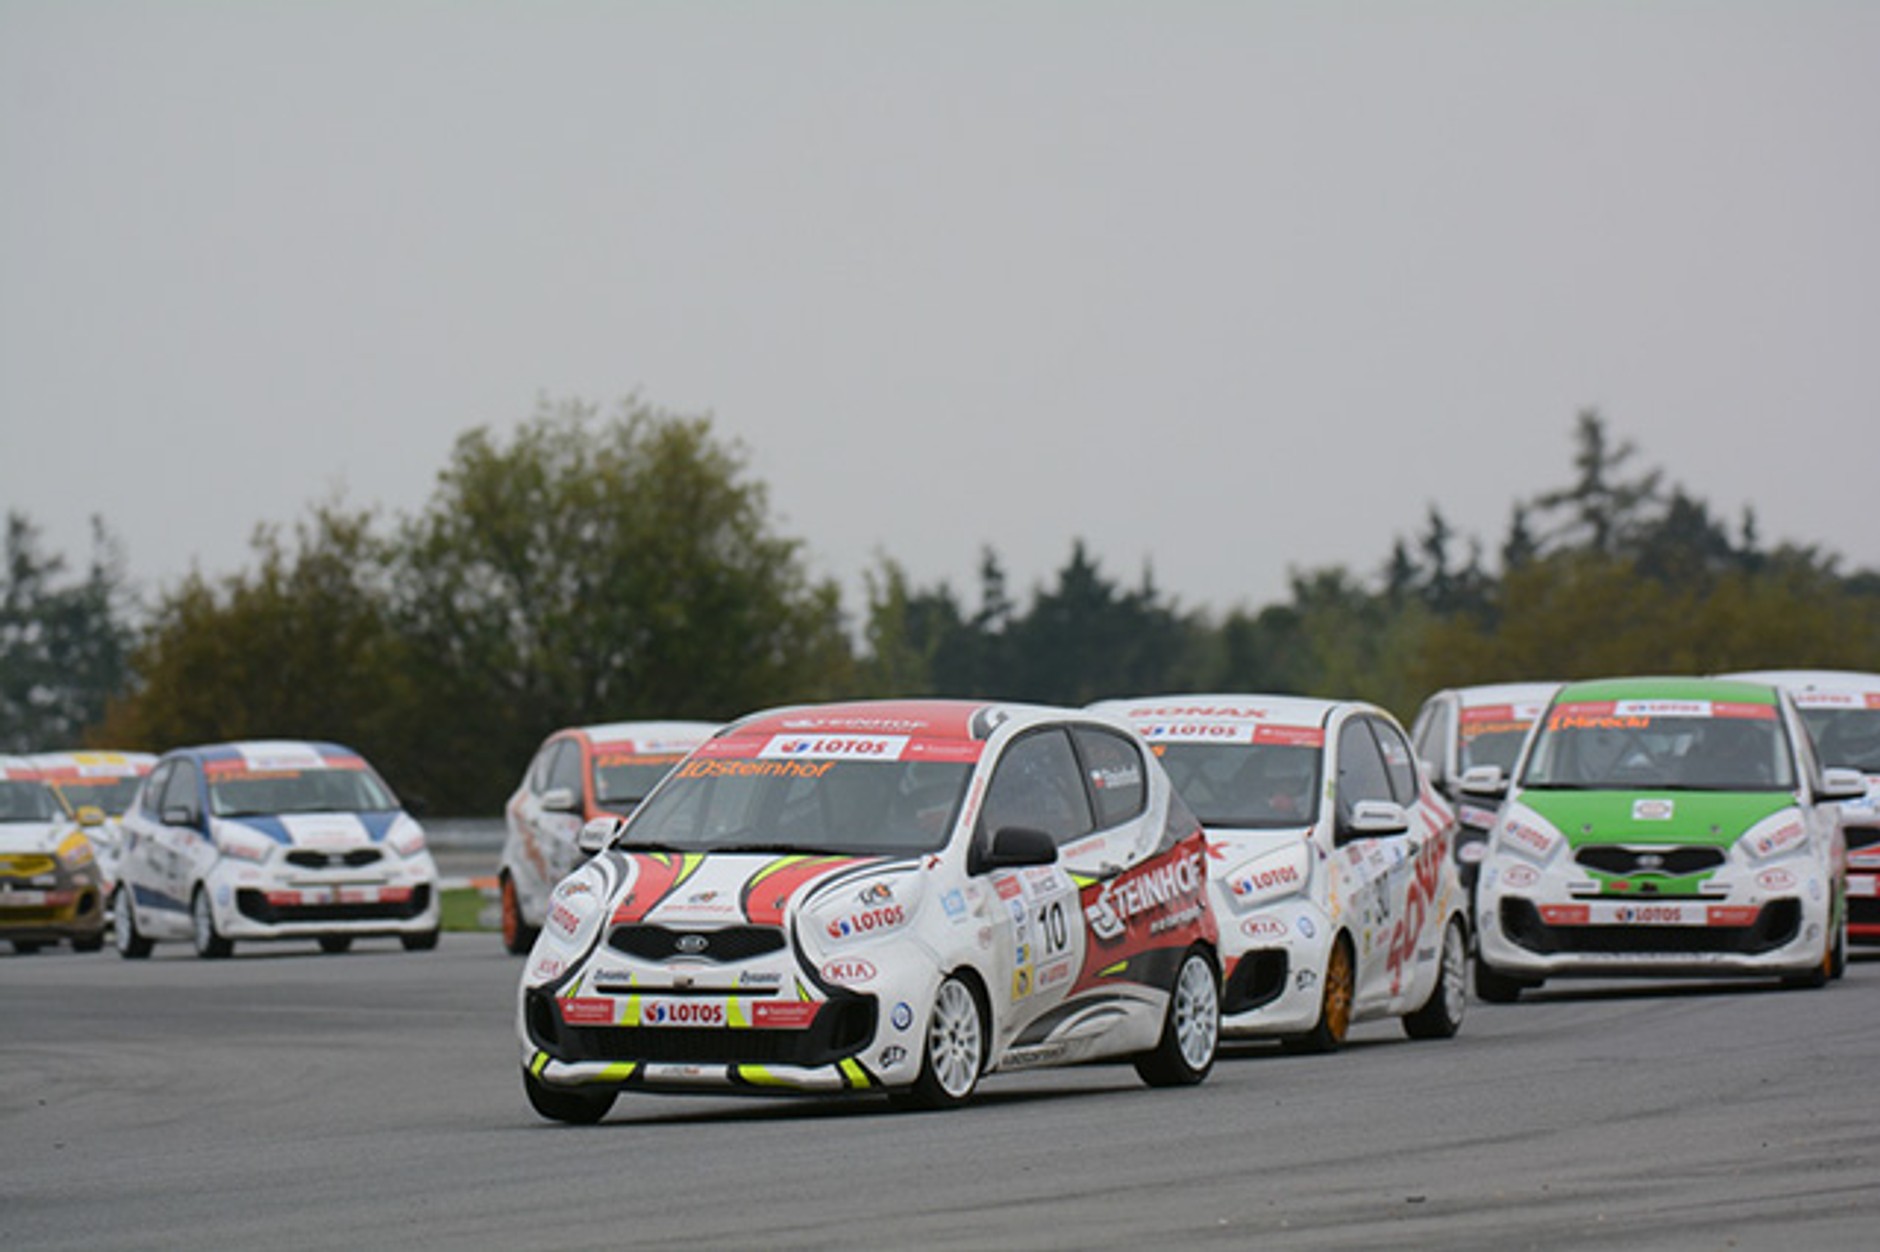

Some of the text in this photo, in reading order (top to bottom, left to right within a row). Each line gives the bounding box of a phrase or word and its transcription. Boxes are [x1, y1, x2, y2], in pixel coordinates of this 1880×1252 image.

[1128, 706, 1268, 718] SONAX
[1169, 724, 1238, 737] LOTOS
[814, 739, 889, 754] LOTOS
[1251, 865, 1299, 890] LOTOS
[1086, 853, 1200, 939] STEINHOF
[852, 905, 904, 933] LOTOS
[1635, 907, 1681, 921] LOTOS
[1038, 901, 1067, 954] 10
[1250, 922, 1278, 934] KIA
[831, 962, 868, 978] KIA
[668, 1003, 723, 1022] LOTOS
